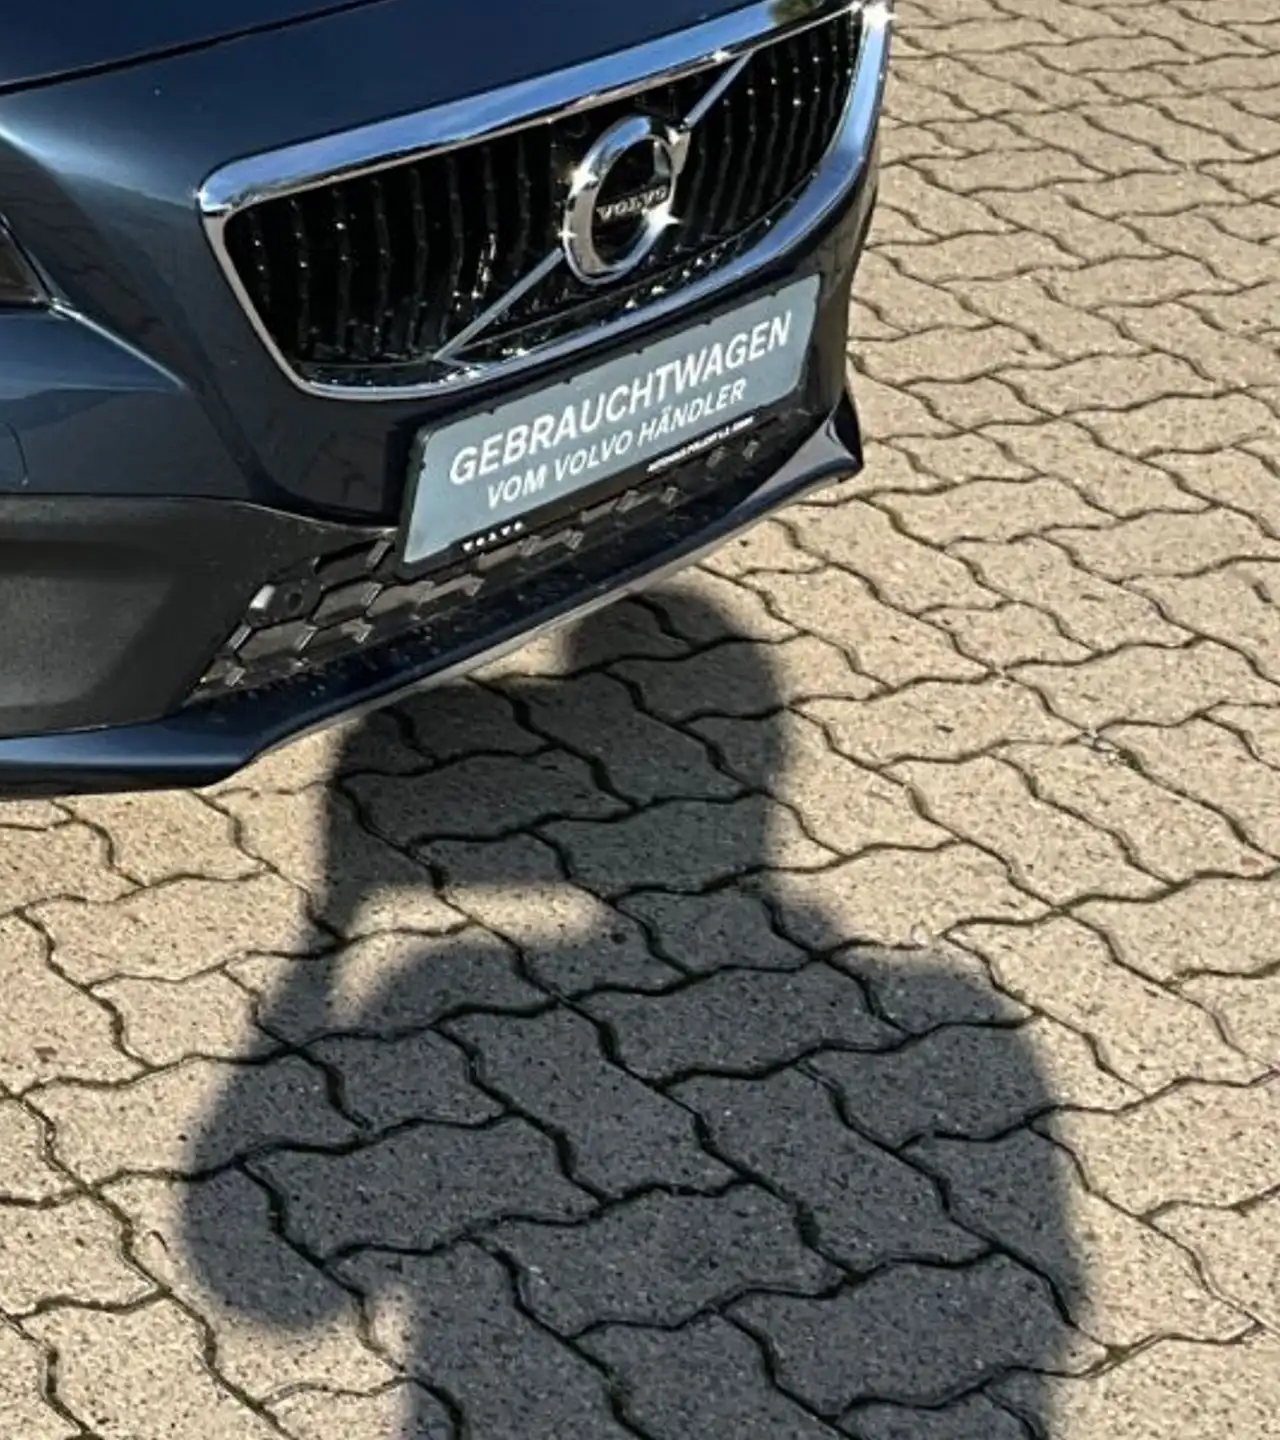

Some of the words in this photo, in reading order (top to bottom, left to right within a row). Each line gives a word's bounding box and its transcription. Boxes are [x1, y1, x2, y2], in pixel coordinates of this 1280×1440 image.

[595, 185, 668, 221] VOLVO
[449, 309, 793, 485] GEBRAUCHTWAGEN
[488, 463, 548, 510] VOM
[554, 430, 634, 482] VOLVO
[637, 377, 748, 448] HÄNDLER
